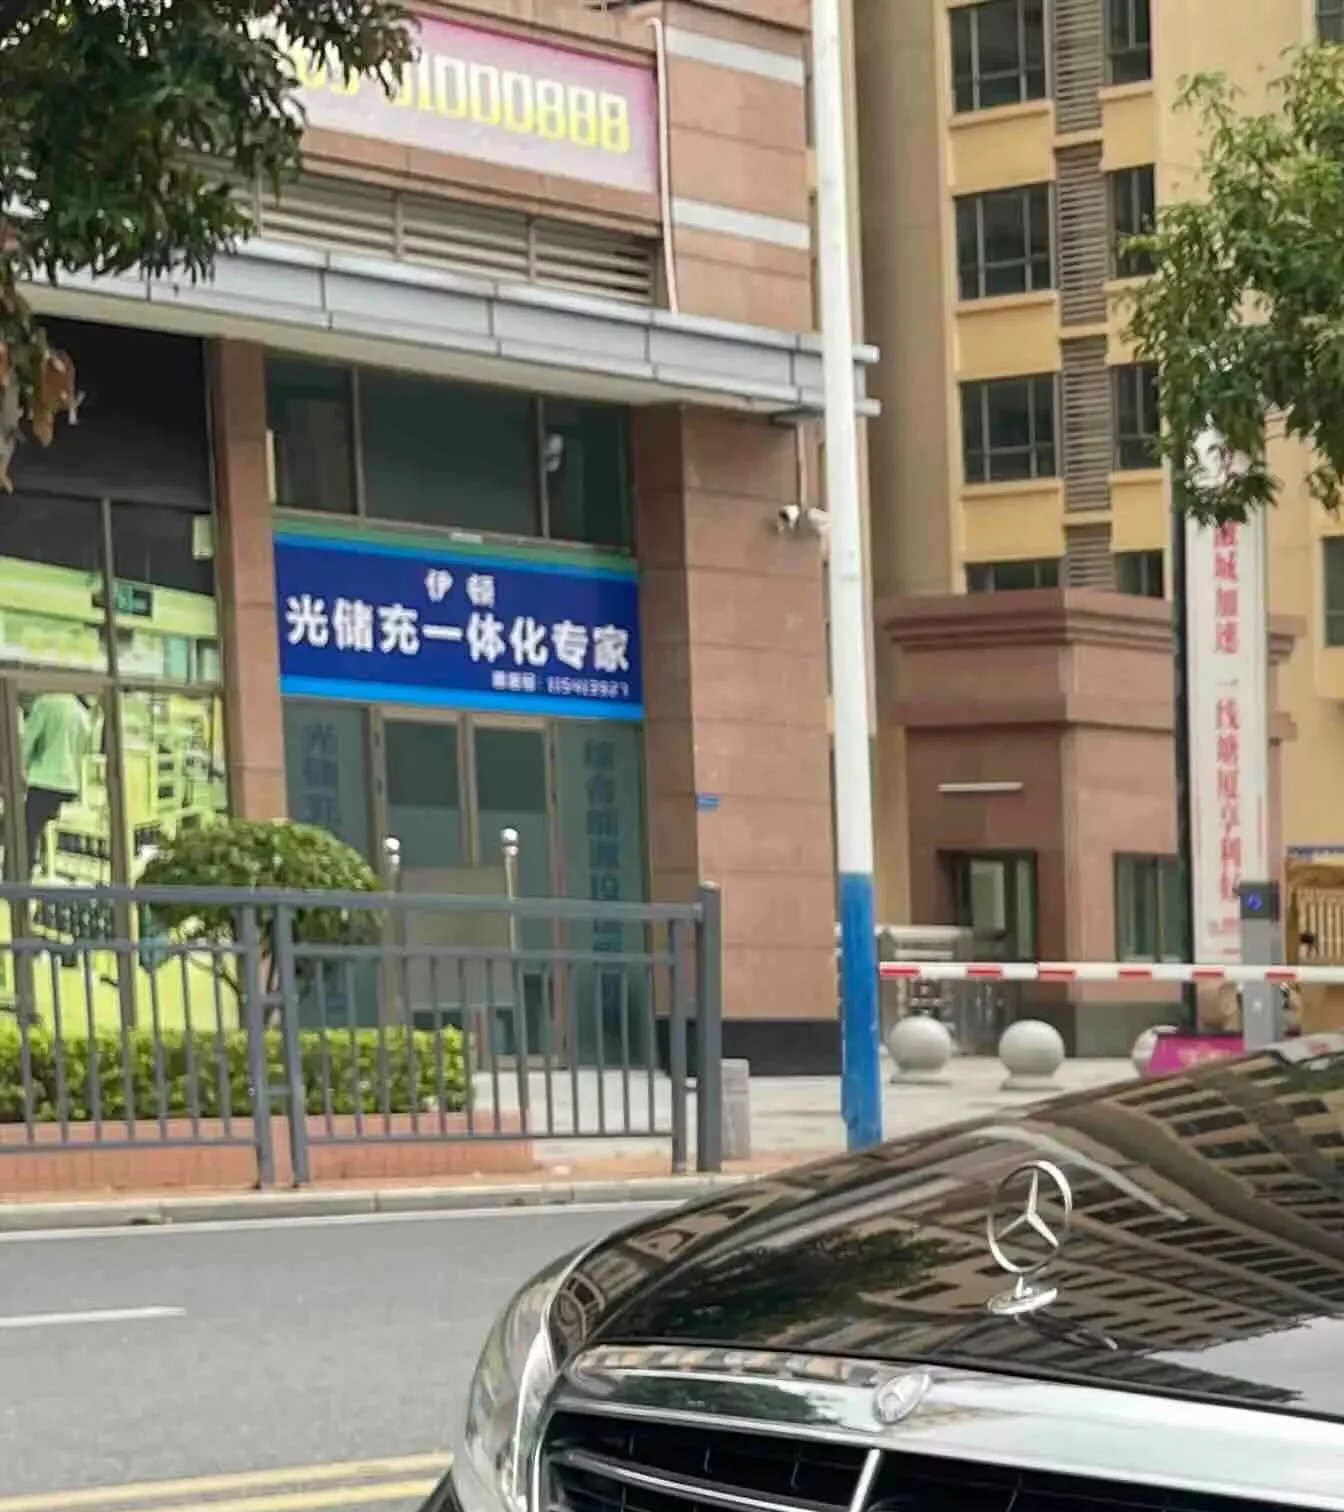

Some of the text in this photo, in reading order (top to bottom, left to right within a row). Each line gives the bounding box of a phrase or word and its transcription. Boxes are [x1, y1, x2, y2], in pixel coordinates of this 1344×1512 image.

[286, 593, 630, 672] 光储充一体化专家
